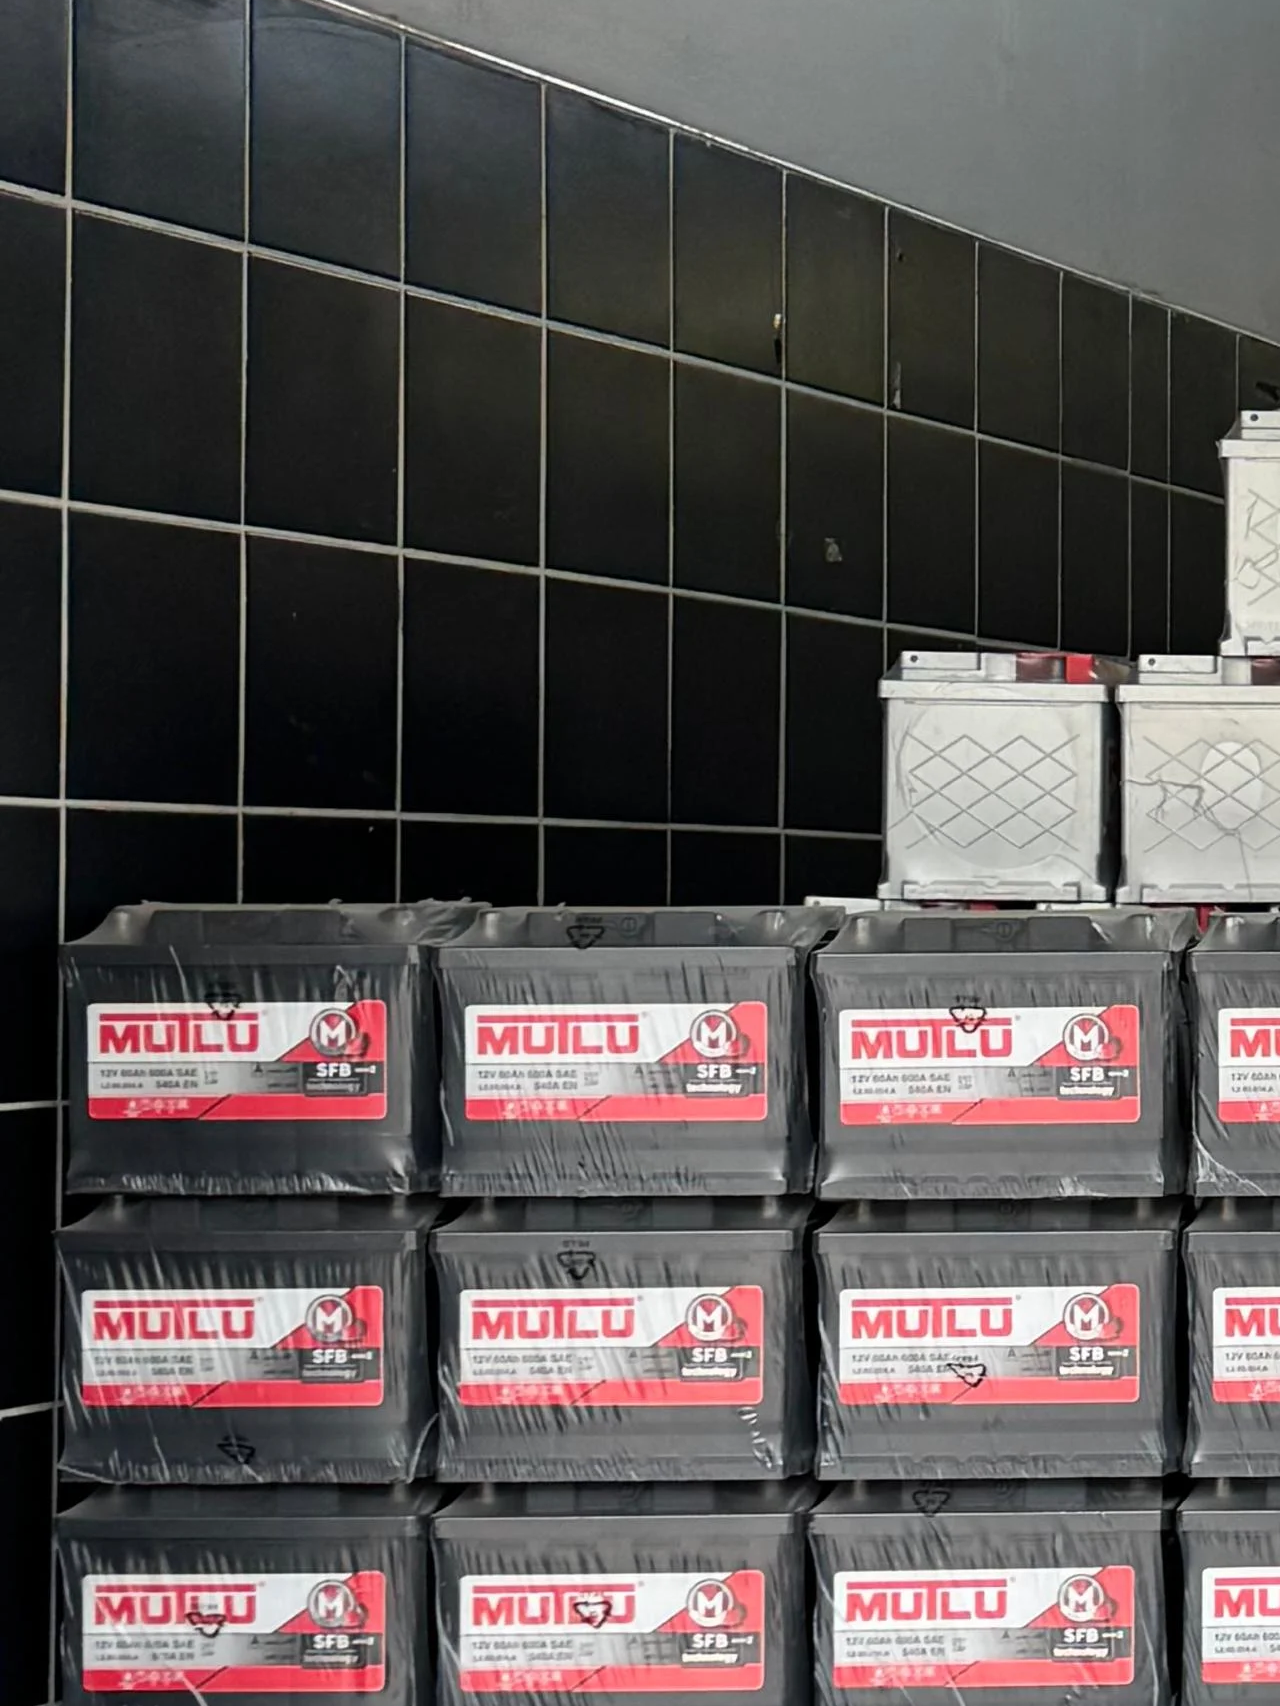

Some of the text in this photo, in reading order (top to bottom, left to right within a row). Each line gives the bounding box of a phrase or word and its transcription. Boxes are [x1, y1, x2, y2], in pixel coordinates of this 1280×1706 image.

[99, 1010, 259, 1054] MUTLU
[477, 1014, 639, 1055] MUTLU
[852, 1018, 1012, 1059] MUTLU
[316, 1063, 352, 1077] SFB
[697, 1064, 732, 1078] SFB
[1070, 1067, 1105, 1081] SFB
[93, 1299, 254, 1341] MUTLU
[472, 1298, 634, 1340] MUTLU
[852, 1298, 1012, 1338] MUTLU
[312, 1349, 348, 1363] SFB
[691, 1348, 728, 1362] SFB
[1069, 1347, 1104, 1361] SFB
[846, 1579, 1006, 1621] MUTLU
[313, 1635, 350, 1648] SFB
[692, 1634, 729, 1648] SFB
[1063, 1628, 1099, 1642] SFB
